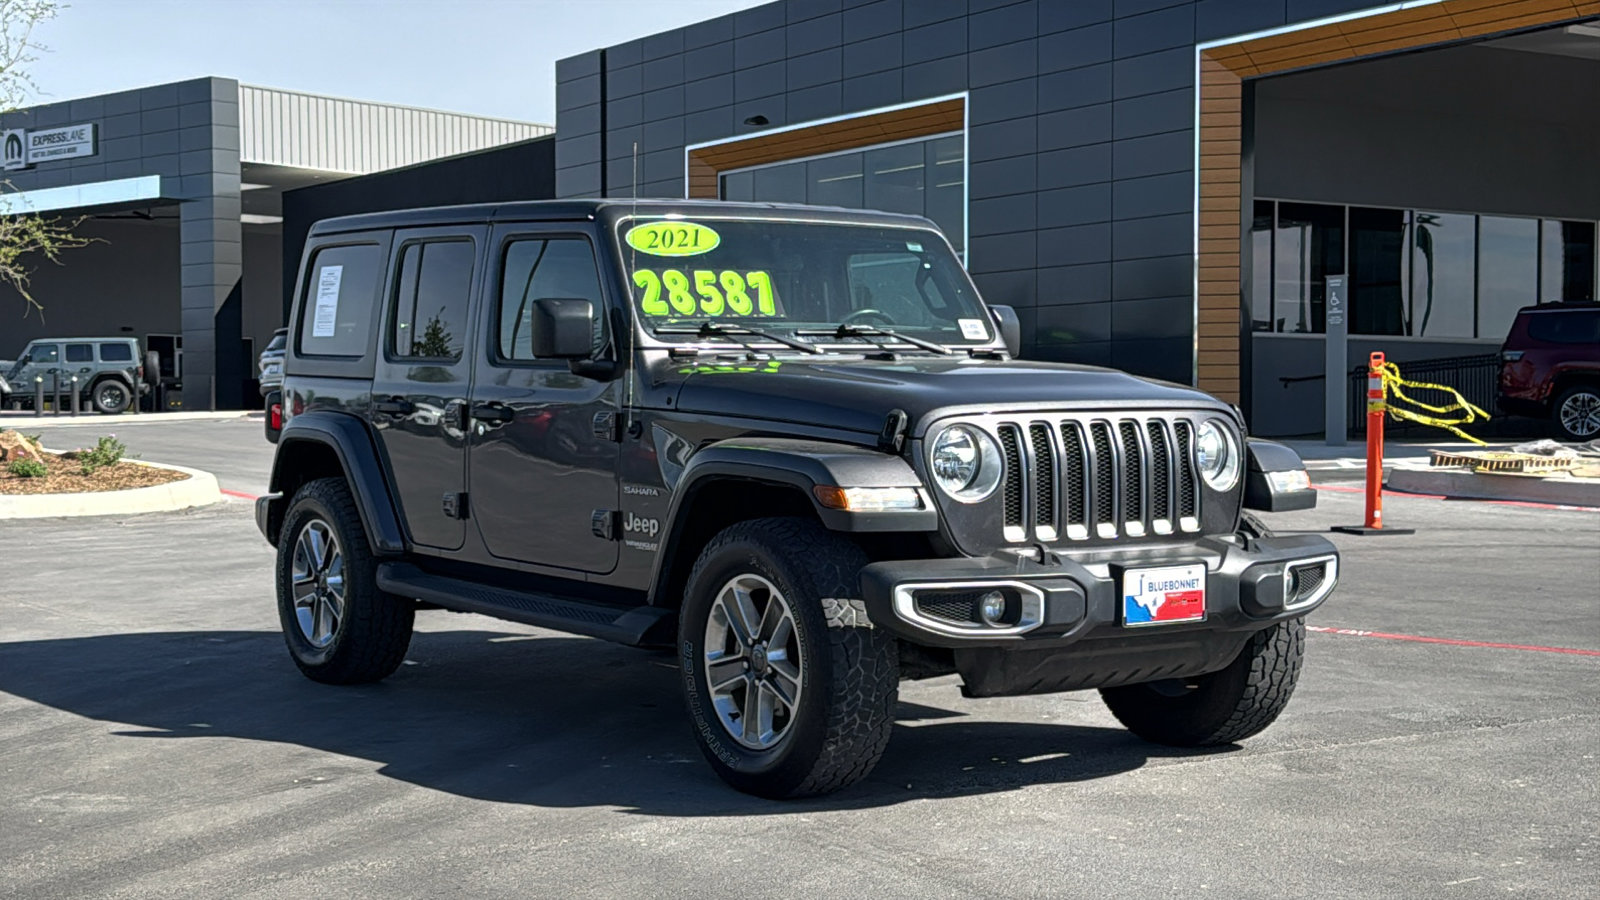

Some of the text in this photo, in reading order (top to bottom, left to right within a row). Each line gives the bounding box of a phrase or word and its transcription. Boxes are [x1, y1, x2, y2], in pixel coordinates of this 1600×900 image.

[647, 229, 700, 249] 2021
[623, 486, 659, 497] SAHARA
[623, 512, 659, 537] Jeep
[1148, 578, 1199, 592] BLUEBONNET
